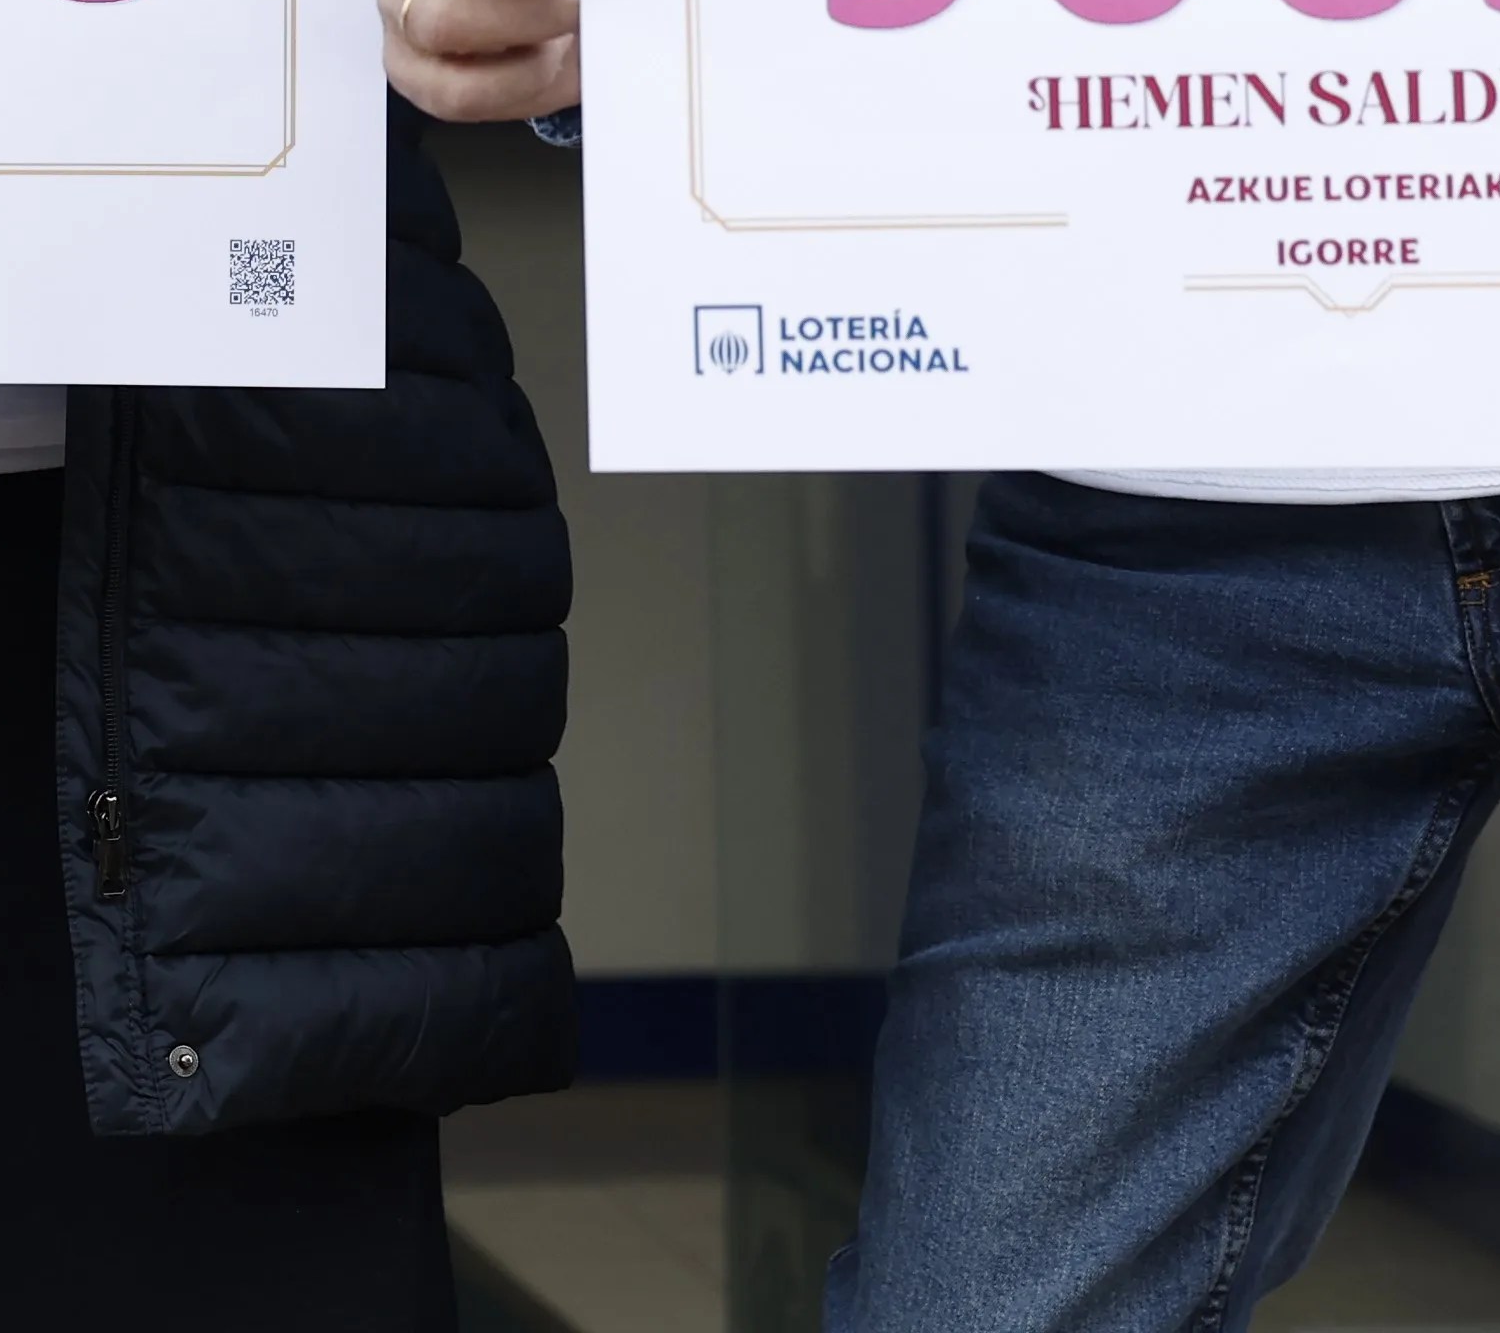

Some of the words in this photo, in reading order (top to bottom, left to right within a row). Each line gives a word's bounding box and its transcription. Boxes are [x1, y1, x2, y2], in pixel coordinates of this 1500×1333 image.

[1028, 72, 1288, 130] HEMEN
[1187, 175, 1313, 204] AZKUE
[1277, 237, 1421, 266] IGORRE
[249, 307, 279, 318] 16470
[780, 309, 930, 342] LOTERÍA
[780, 347, 970, 374] NACIONAL
